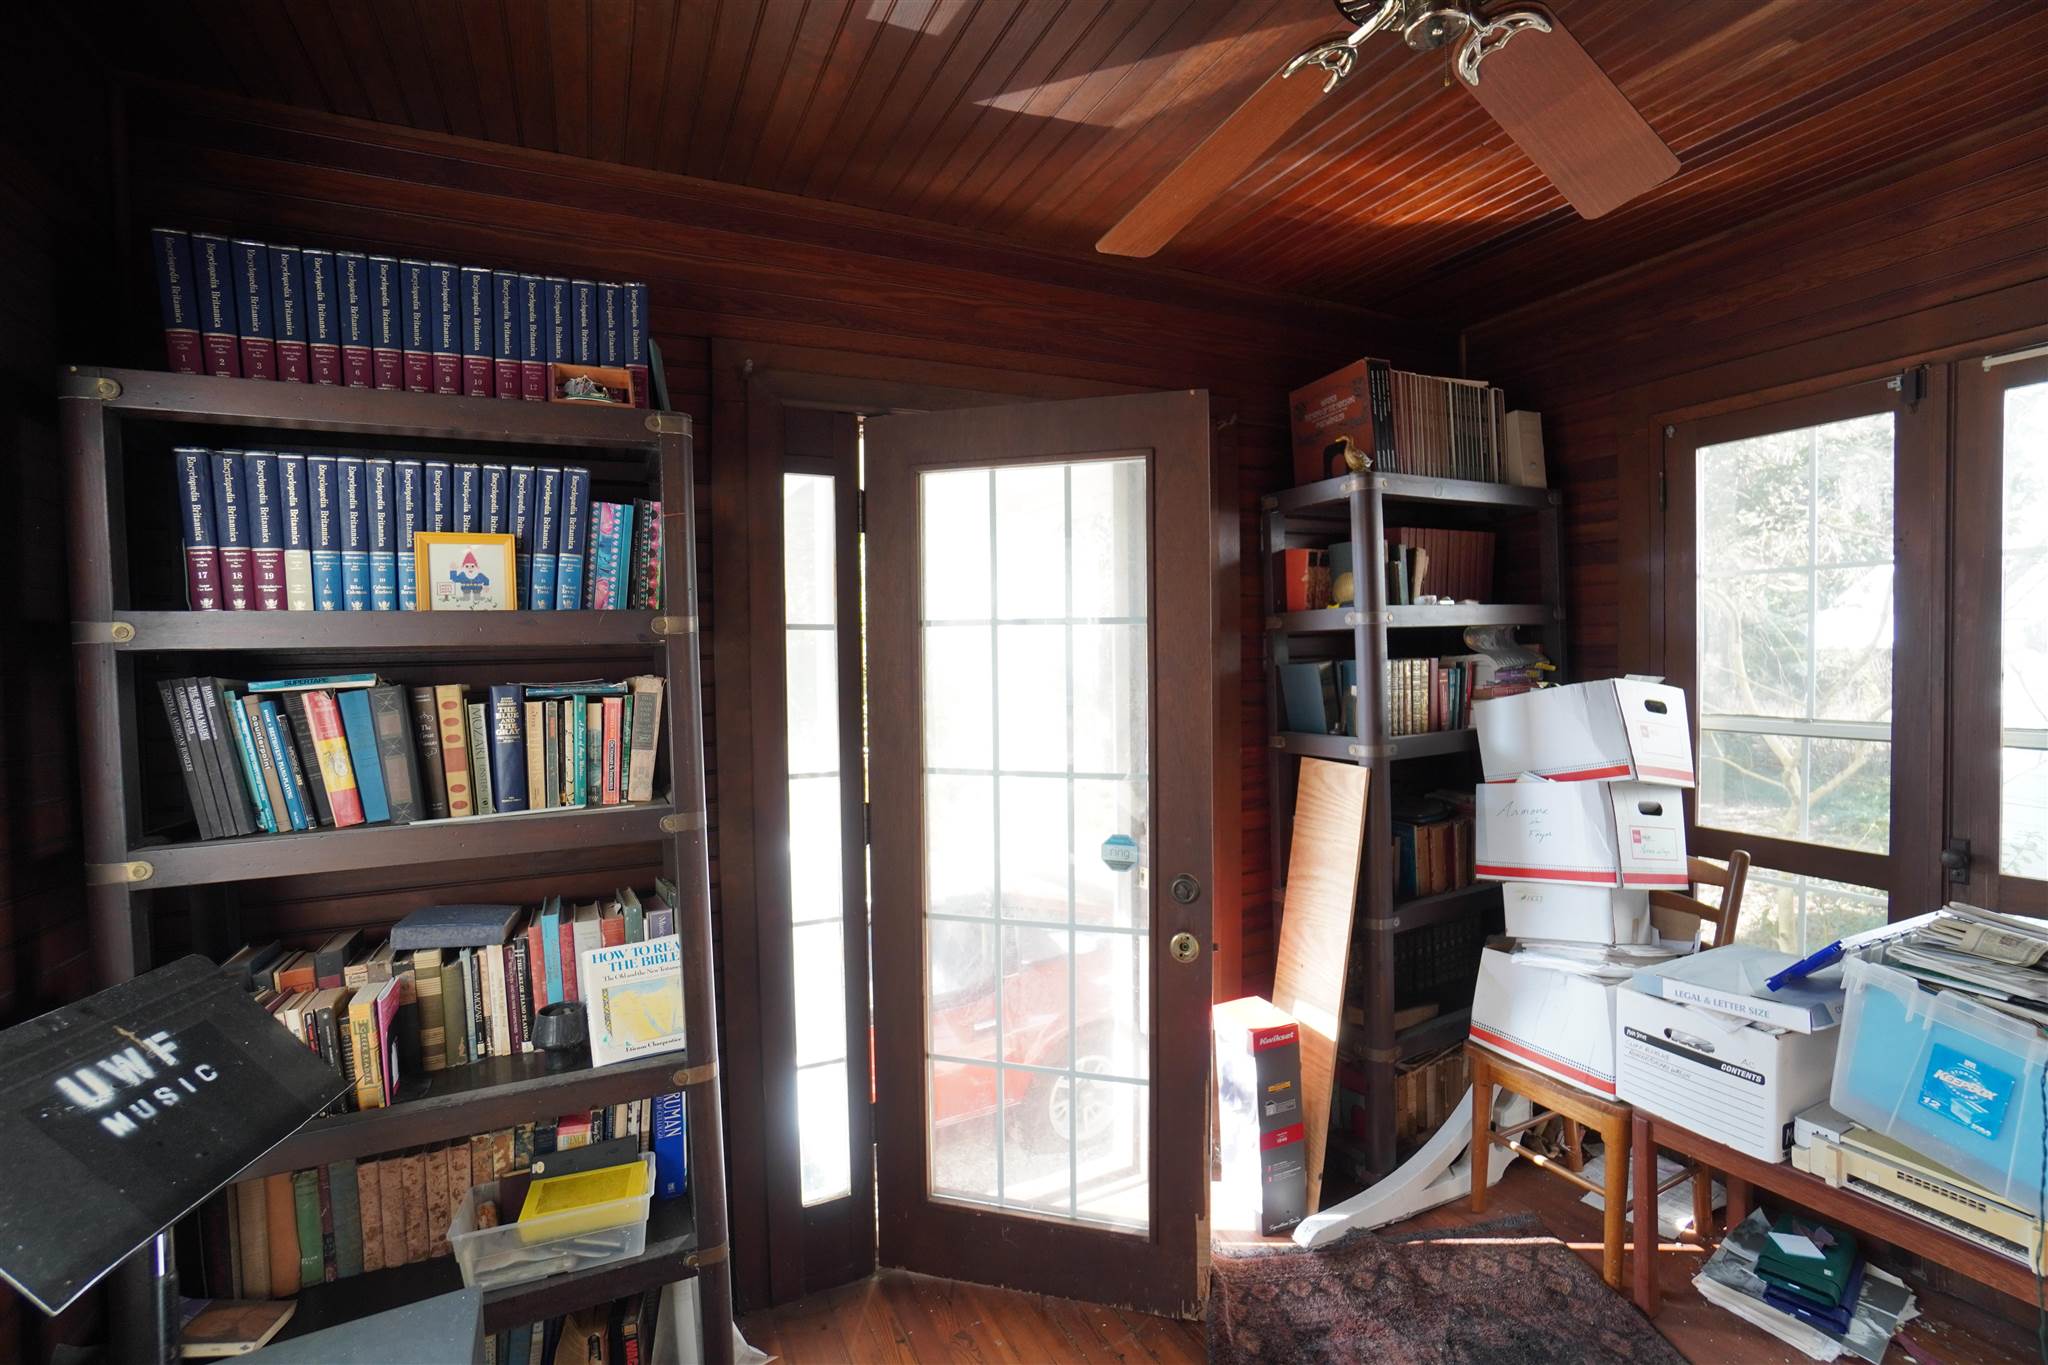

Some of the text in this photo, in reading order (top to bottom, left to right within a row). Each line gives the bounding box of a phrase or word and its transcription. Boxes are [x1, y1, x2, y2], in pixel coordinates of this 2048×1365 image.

[192, 505, 203, 541] Britannica
[228, 506, 238, 542] Britannica
[261, 507, 270, 543] Britannica
[290, 509, 299, 544] Britannica
[321, 511, 329, 546] Britannica
[350, 512, 358, 546] Britannica
[406, 514, 414, 549] Britannica
[568, 517, 576, 549] Britannica
[204, 685, 216, 708] HAWAII
[283, 678, 328, 687] SUPERTAPE
[193, 698, 205, 719] SIERRA
[495, 712, 519, 720] BLUE
[186, 718, 195, 735] ISLES
[252, 715, 271, 770] counterpoint
[471, 706, 485, 761] MOZART
[180, 746, 193, 772] JUNGLES
[1109, 848, 1130, 859] ring
[591, 942, 680, 964] HOW TO REA
[609, 952, 680, 972] THE BIBLE
[473, 992, 482, 1023] MOZART
[1674, 989, 1770, 1019] LEGAL & LETTER SIZE
[359, 1024, 373, 1084] GREEK READER
[1259, 1031, 1294, 1046] Kwikset
[55, 1031, 180, 1109] UWF
[1721, 1063, 1763, 1084] CONTENTS
[1933, 1068, 1999, 1102] KEEPBOX
[100, 1063, 219, 1138] MUSIC
[663, 1092, 681, 1137] RUMAN
[1922, 1096, 1941, 1110] 12
